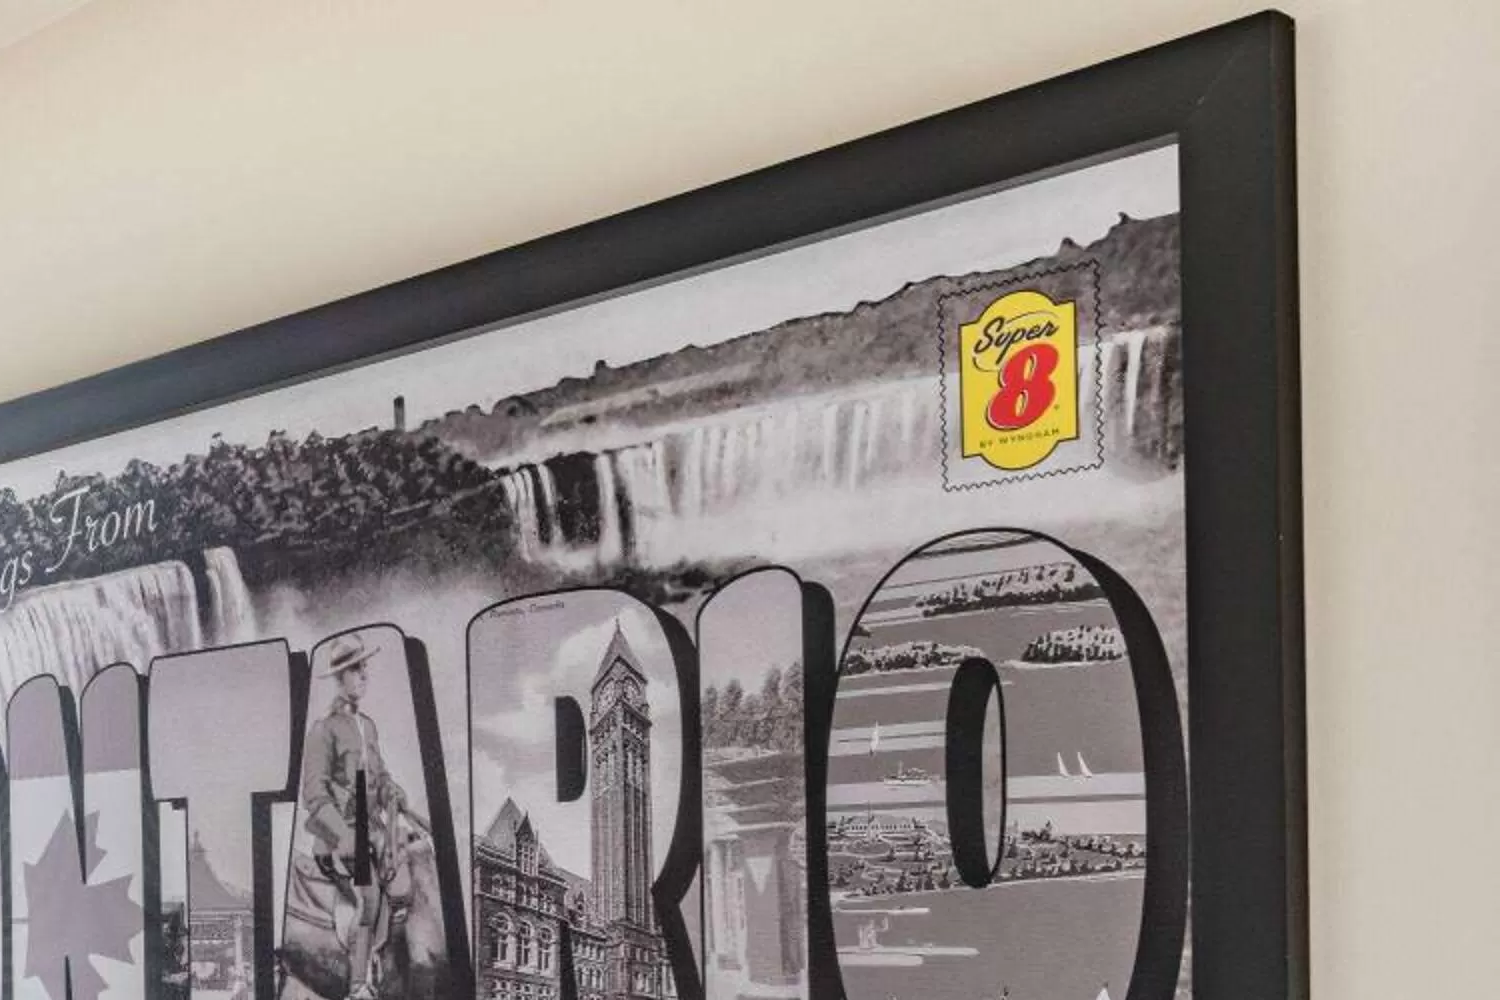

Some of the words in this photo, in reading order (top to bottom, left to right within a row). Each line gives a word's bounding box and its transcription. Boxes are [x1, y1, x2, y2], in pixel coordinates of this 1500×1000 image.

[973, 315, 1059, 365] Super
[985, 341, 1060, 432] 8
[44, 485, 158, 573] From
